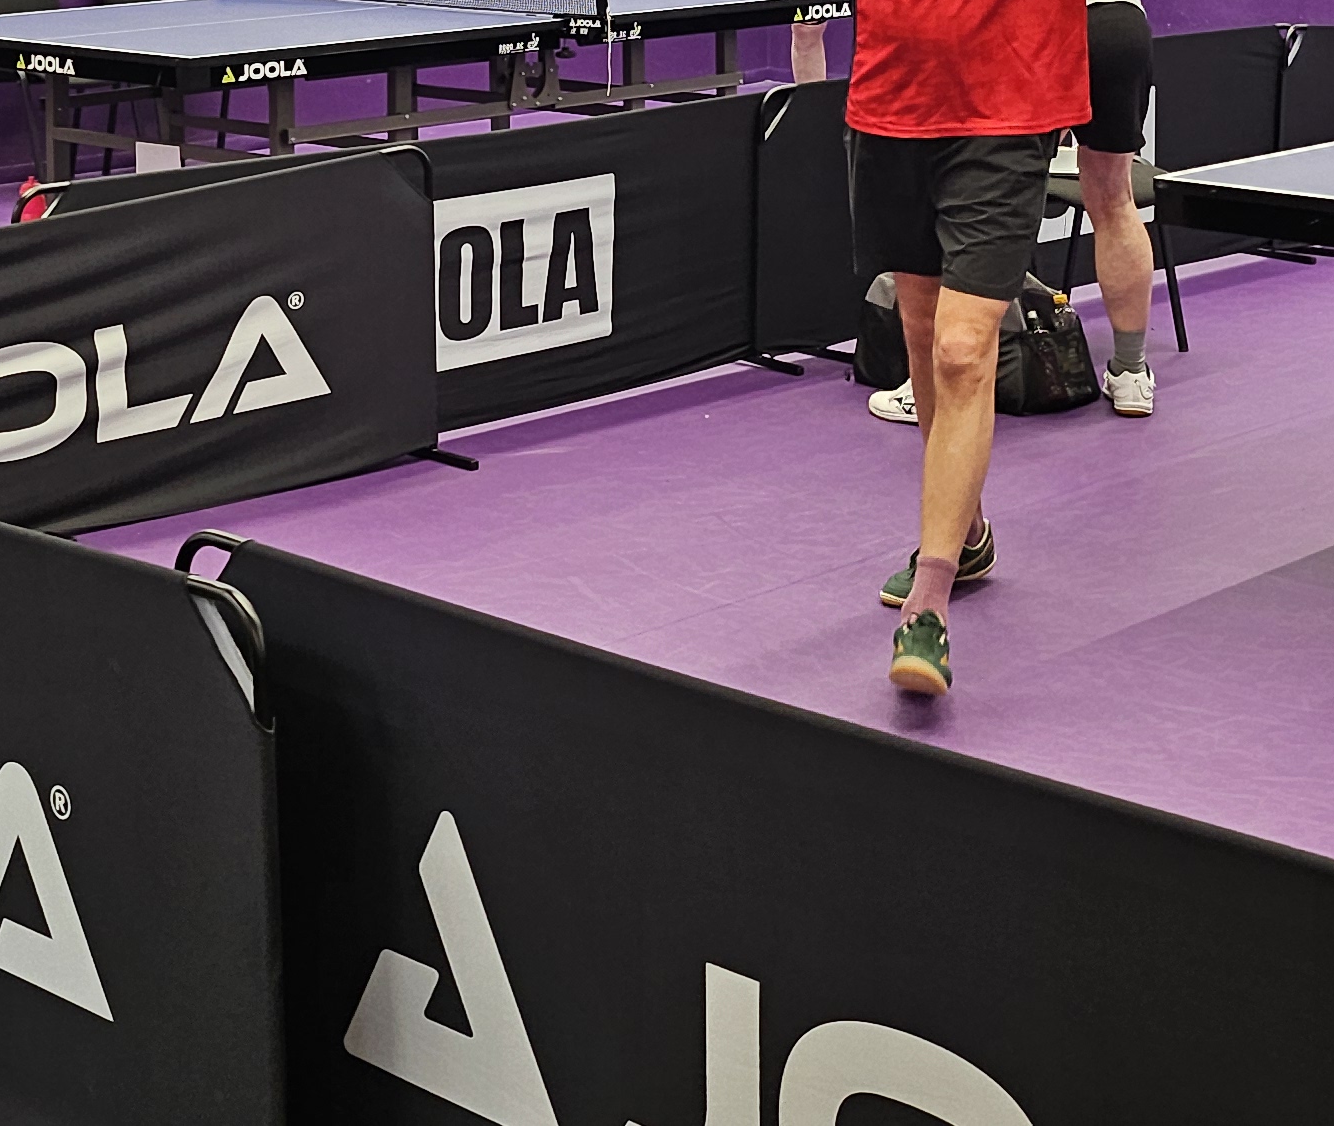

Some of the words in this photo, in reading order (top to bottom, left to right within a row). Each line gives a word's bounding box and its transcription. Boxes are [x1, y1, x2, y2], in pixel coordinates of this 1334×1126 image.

[805, 2, 851, 21] JOOLA
[27, 54, 75, 75] JOOLA
[238, 59, 307, 81] JOOLA
